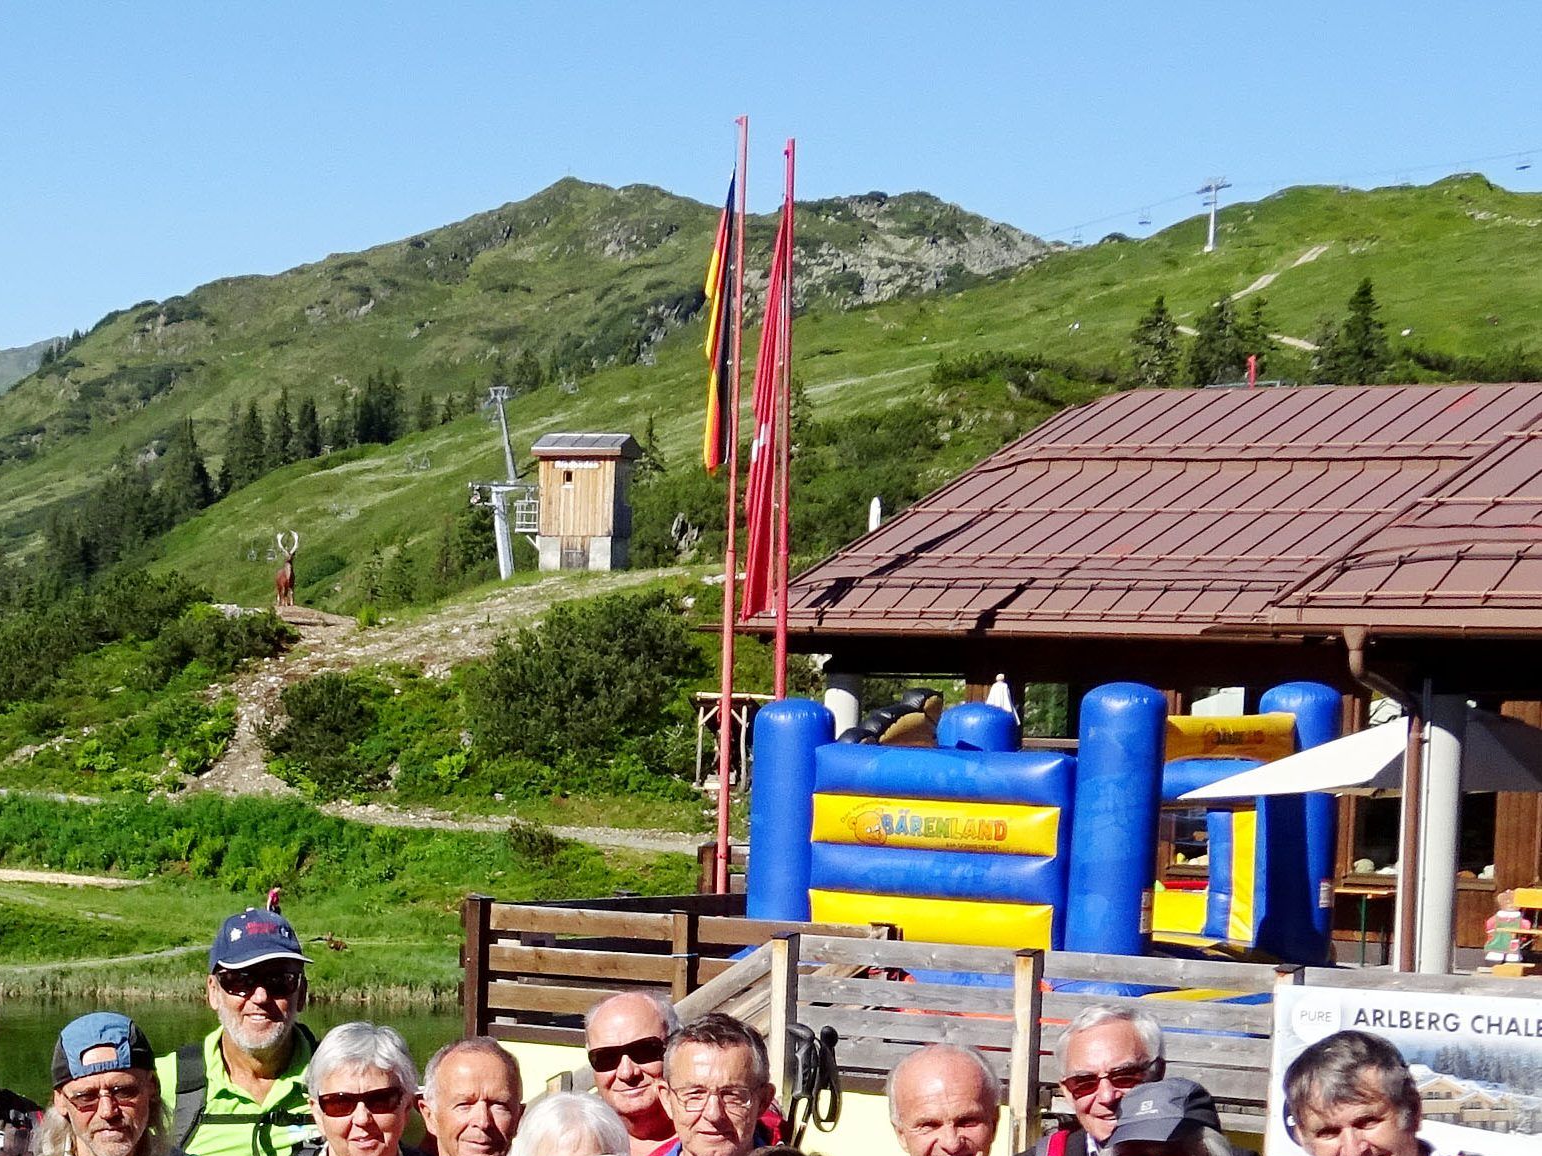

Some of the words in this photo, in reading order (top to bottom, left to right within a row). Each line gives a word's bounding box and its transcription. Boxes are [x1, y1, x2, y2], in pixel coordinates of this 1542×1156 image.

[880, 809, 1008, 842] BÄRENLAND
[1300, 1010, 1332, 1023] PURE
[1353, 1007, 1460, 1032] ARLBERG
